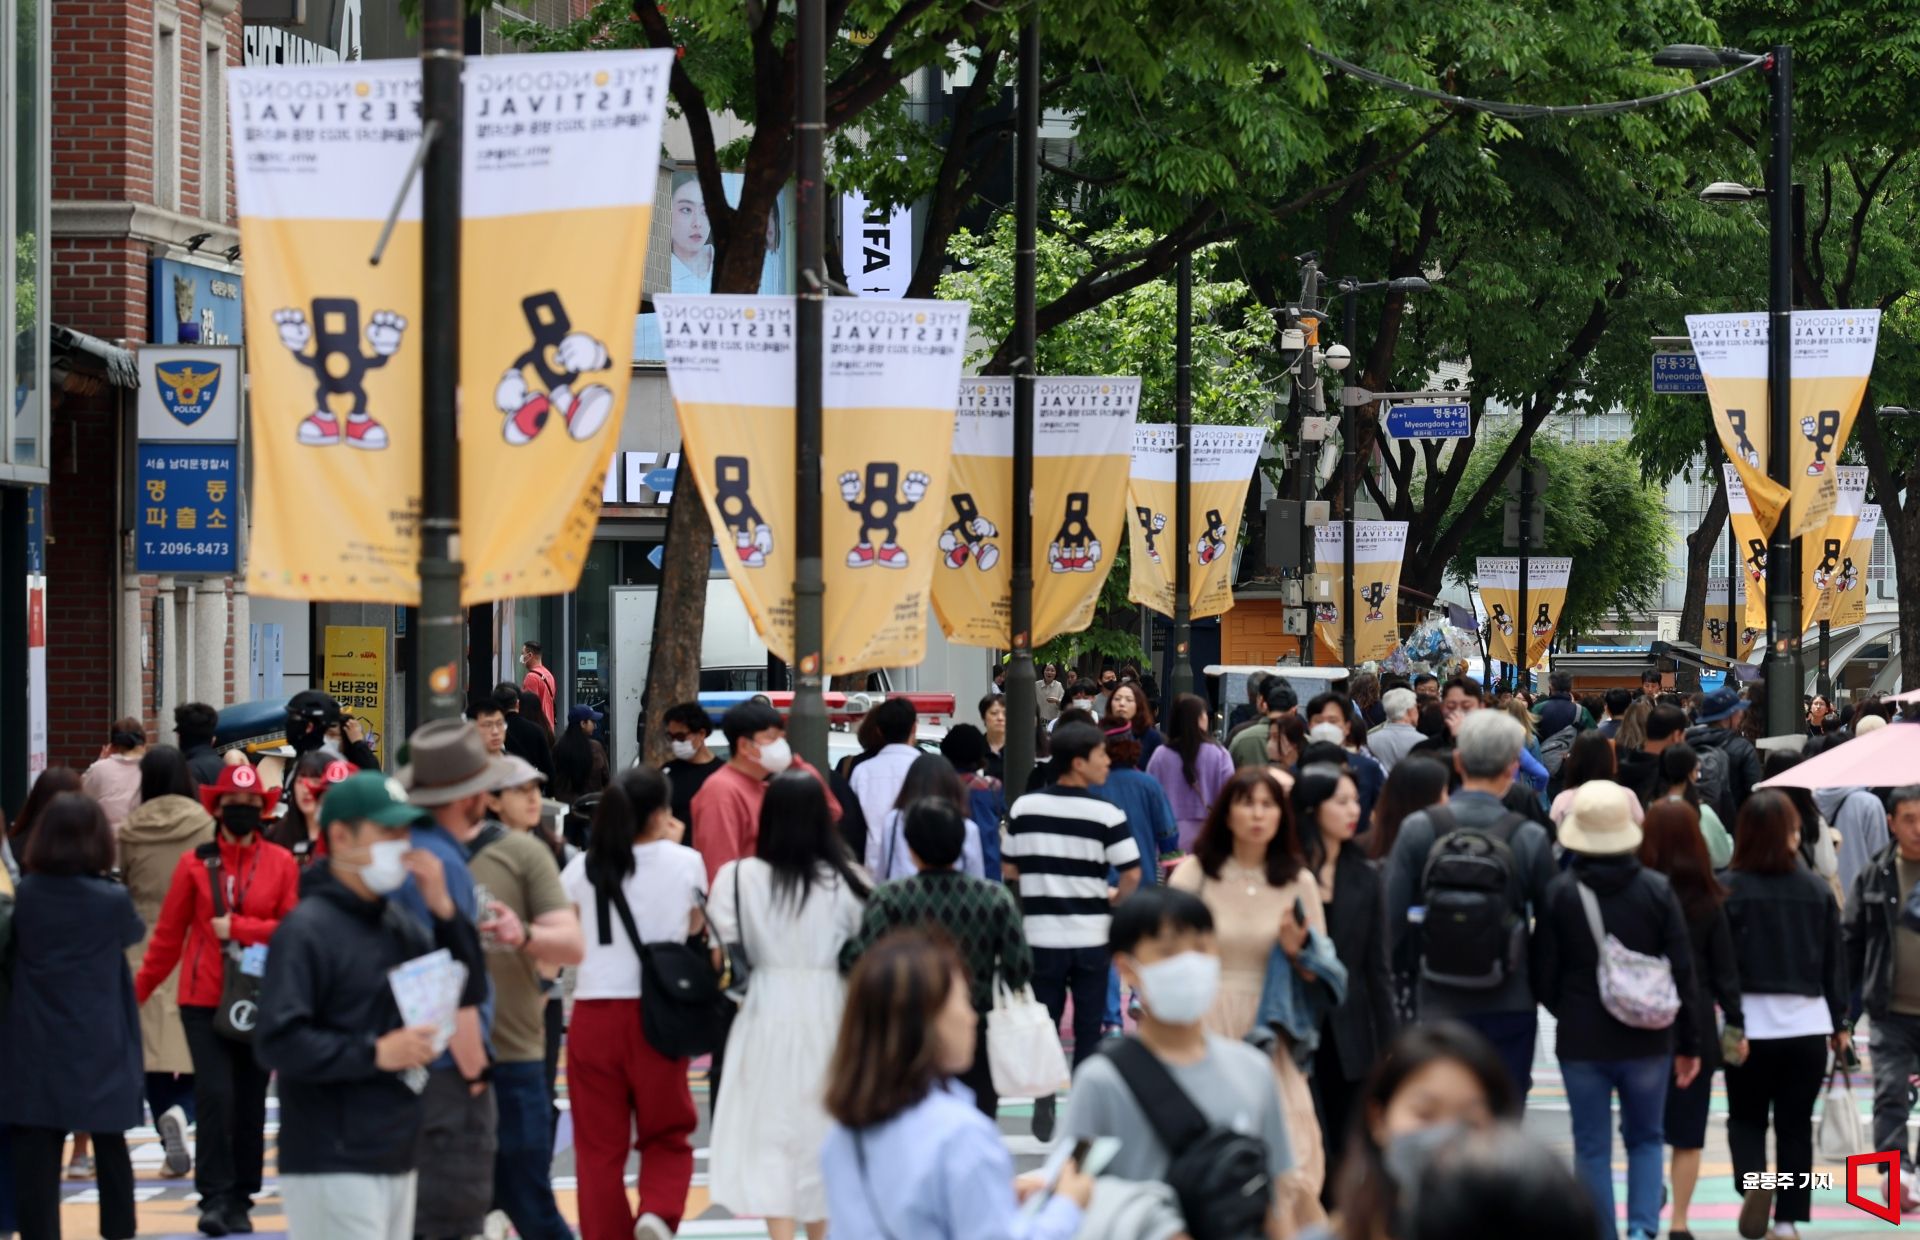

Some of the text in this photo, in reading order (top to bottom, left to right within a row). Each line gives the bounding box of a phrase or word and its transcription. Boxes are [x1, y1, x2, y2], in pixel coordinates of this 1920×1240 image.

[1656, 357, 1696, 369] 명동3길
[173, 405, 202, 414] POLICE
[1433, 407, 1467, 419] 명동4길
[1404, 420, 1467, 429] Myeongdong 4-gil
[146, 458, 229, 471] 서울 남대문경찰서
[146, 506, 227, 529] 파출소
[145, 542, 229, 555] T. 2096-8473
[329, 681, 378, 694] 난타공연
